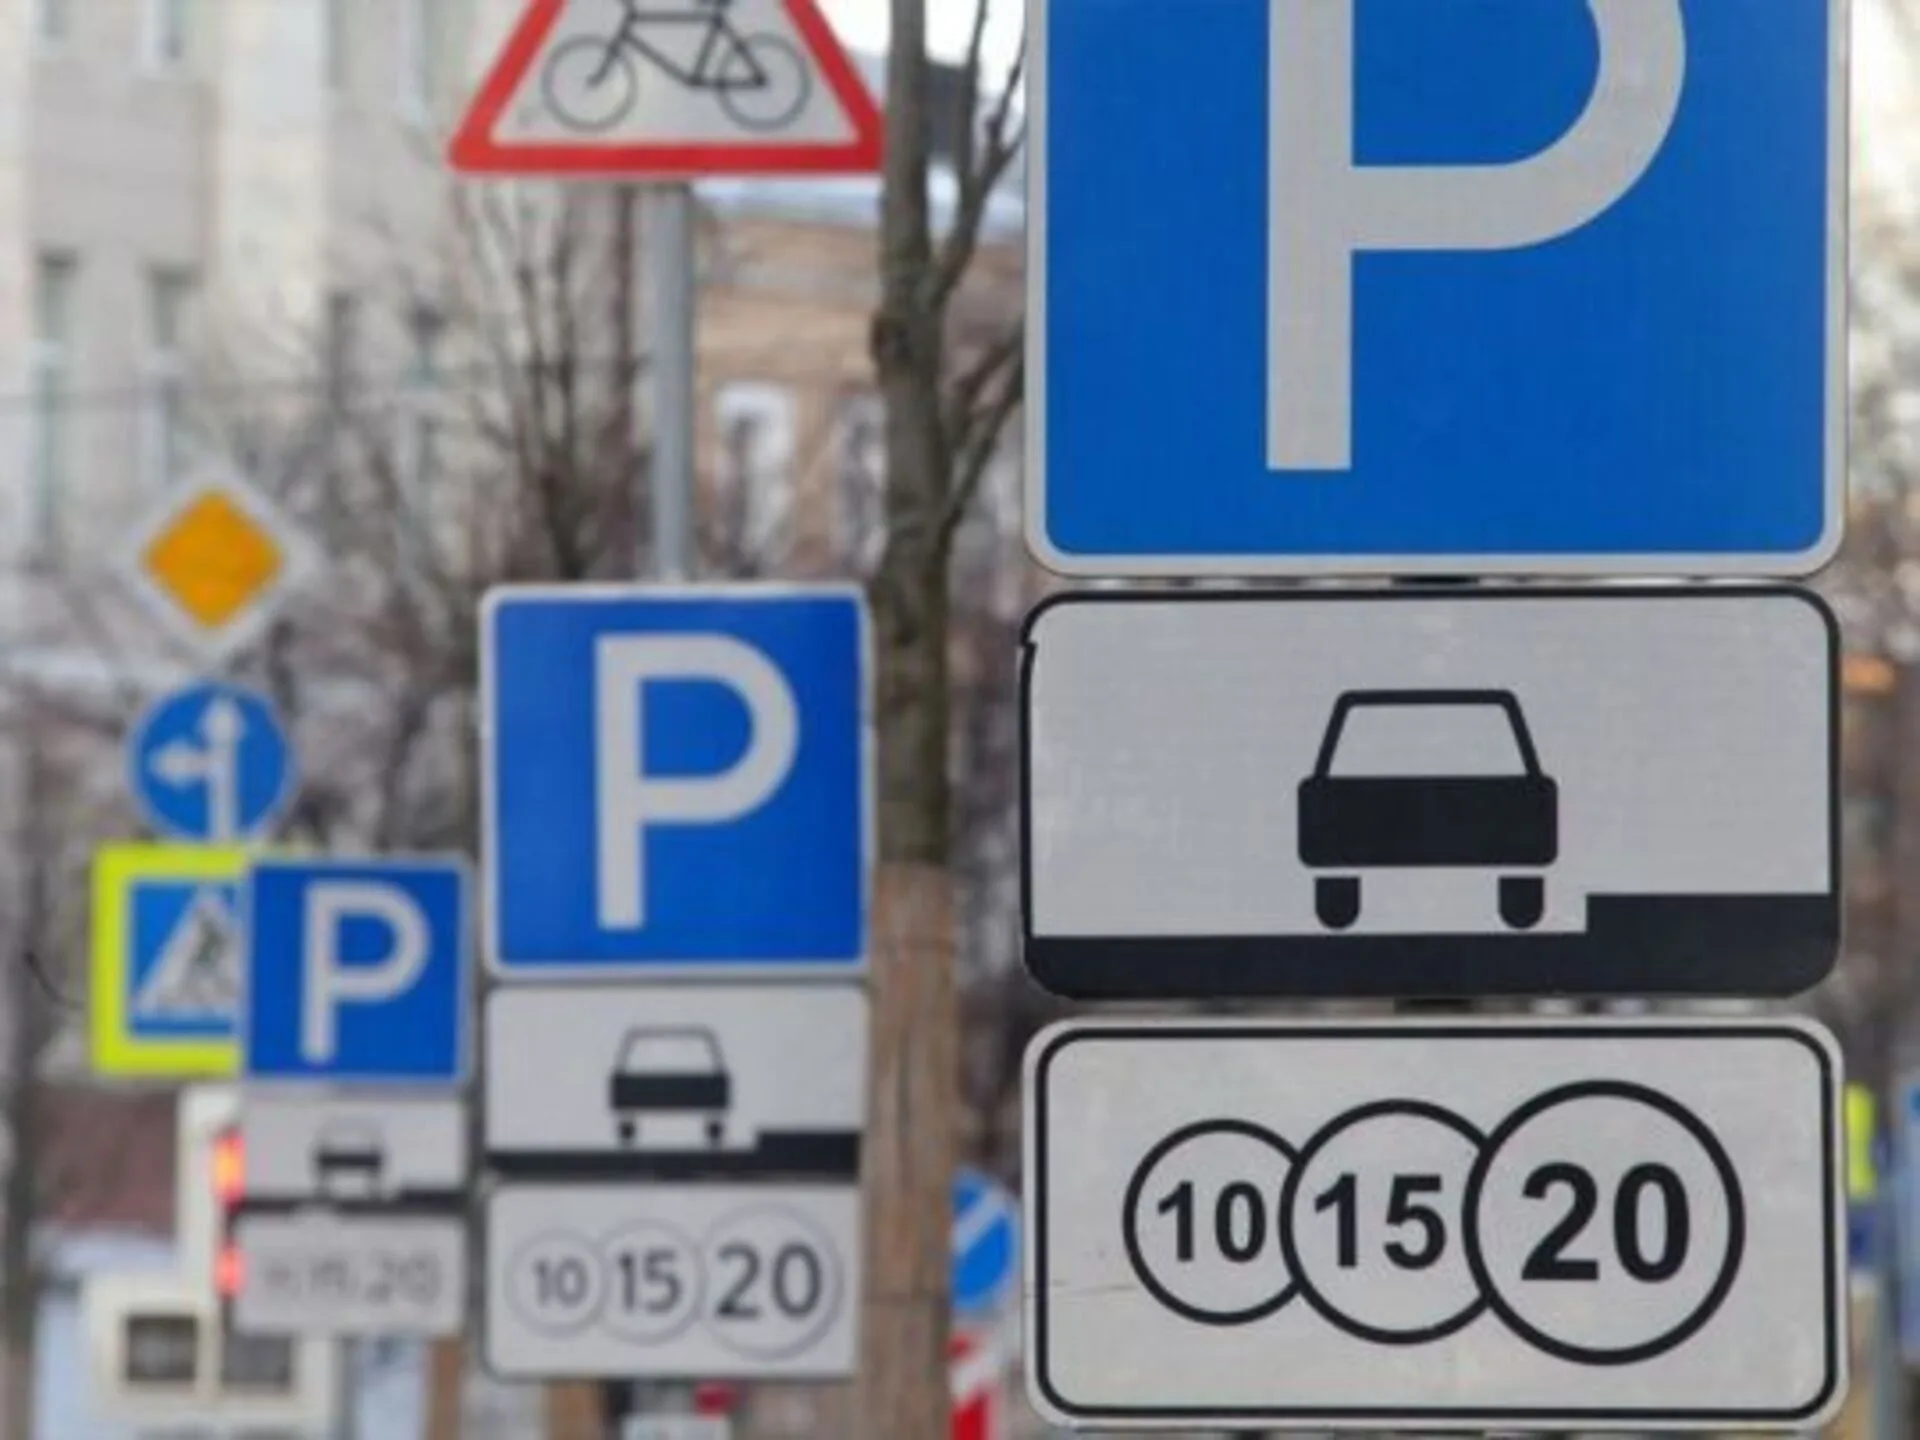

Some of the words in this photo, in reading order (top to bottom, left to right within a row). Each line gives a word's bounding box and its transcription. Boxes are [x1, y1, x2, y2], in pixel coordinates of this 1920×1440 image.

[1266, 0, 1687, 470] P
[595, 634, 799, 930] P
[302, 880, 430, 1062] P
[533, 1260, 588, 1306] 10
[617, 1248, 682, 1313] 15
[714, 1242, 822, 1319] 20
[1157, 1181, 1267, 1263] 10
[1313, 1173, 1447, 1269] 15
[1521, 1162, 1691, 1283] 20
